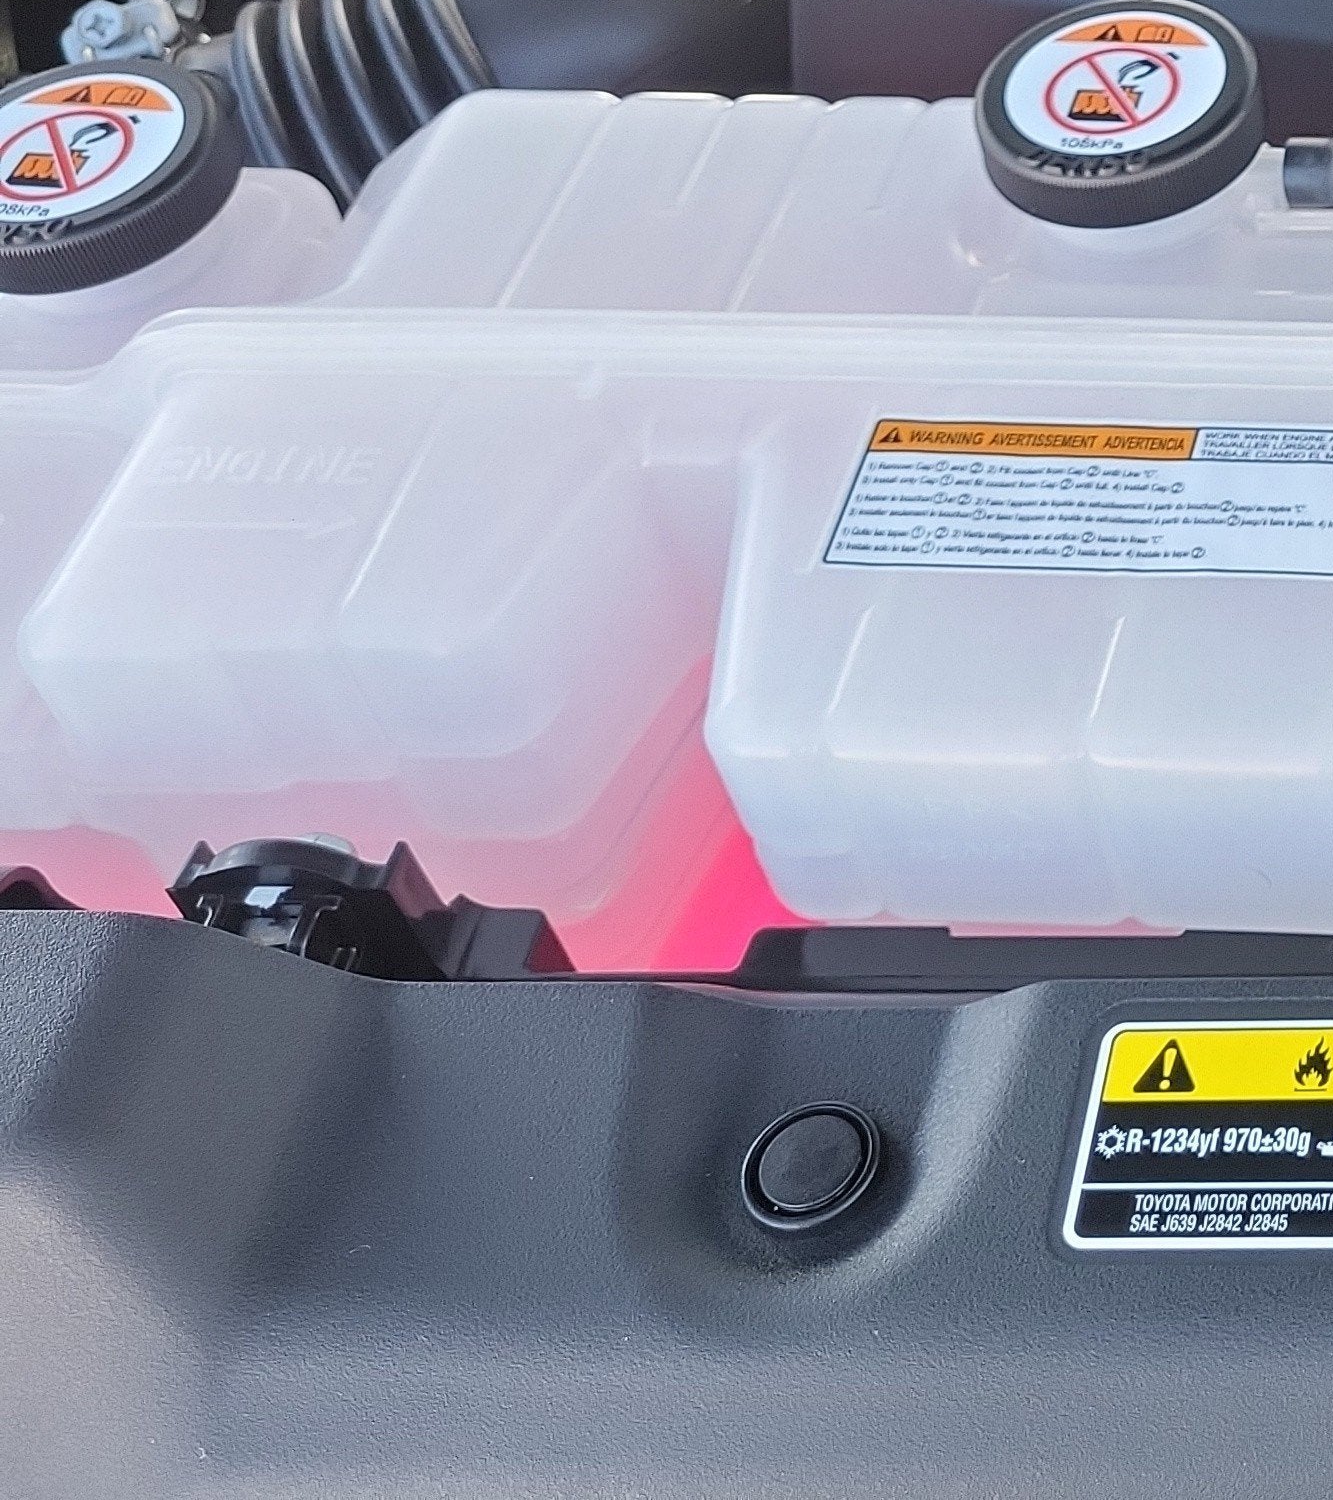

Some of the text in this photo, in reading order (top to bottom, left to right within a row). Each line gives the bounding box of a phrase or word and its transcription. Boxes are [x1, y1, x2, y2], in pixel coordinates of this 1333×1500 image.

[909, 429, 1186, 451] WARNING AVERTISSEMENT ADVERTENCIA
[1126, 1127, 1221, 1158] R-1234yf
[1222, 1127, 1312, 1157] 970±30g
[1134, 1194, 1191, 1212] TOYOTA
[1193, 1194, 1248, 1212] MOTOR
[1129, 1214, 1289, 1232] SAE J639 J2842 J2845
